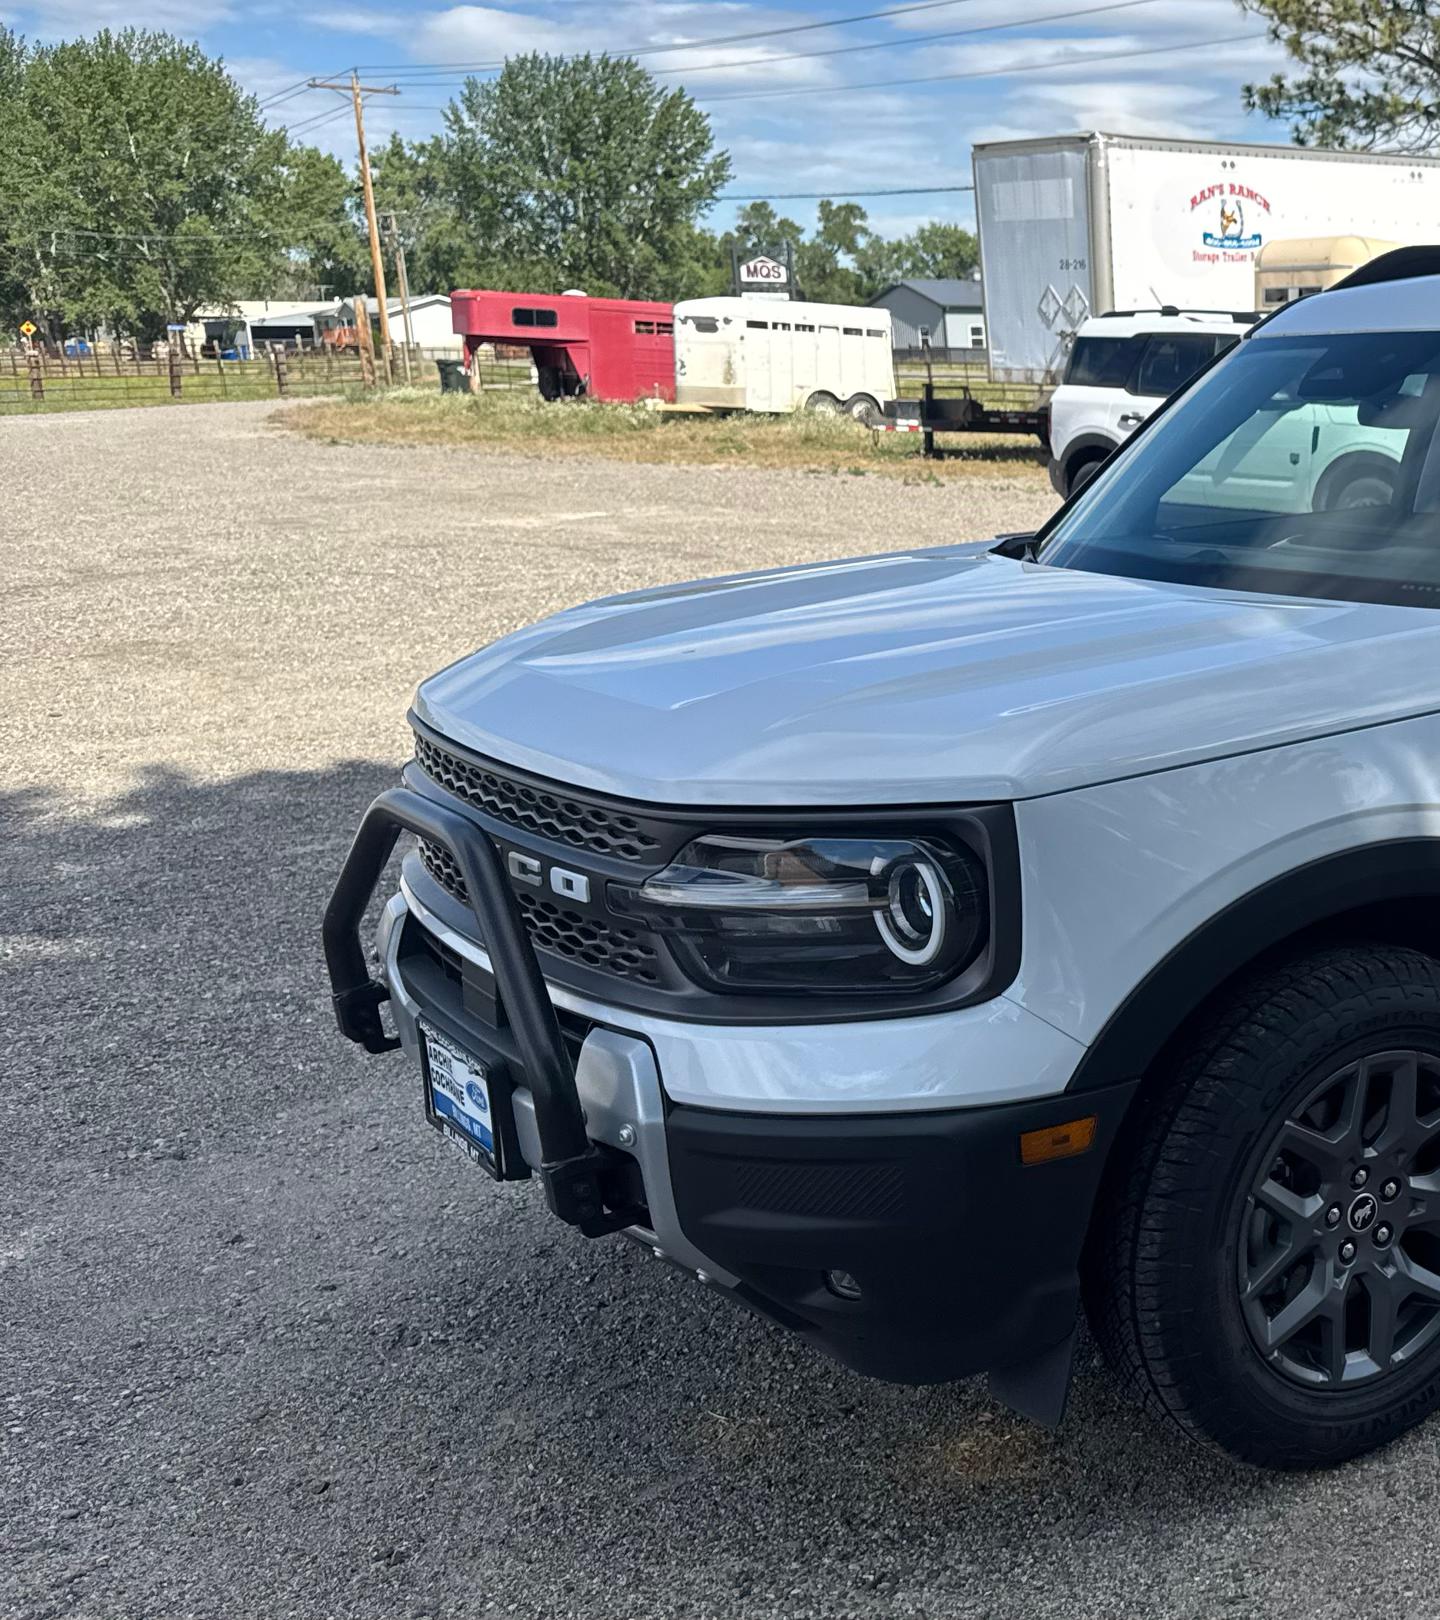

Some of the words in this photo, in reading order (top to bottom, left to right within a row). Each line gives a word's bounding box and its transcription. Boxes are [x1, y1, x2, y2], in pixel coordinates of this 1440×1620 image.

[1229, 183, 1271, 214] RANCH
[746, 264, 781, 279] MQS
[428, 1045, 453, 1075] ARCHIE
